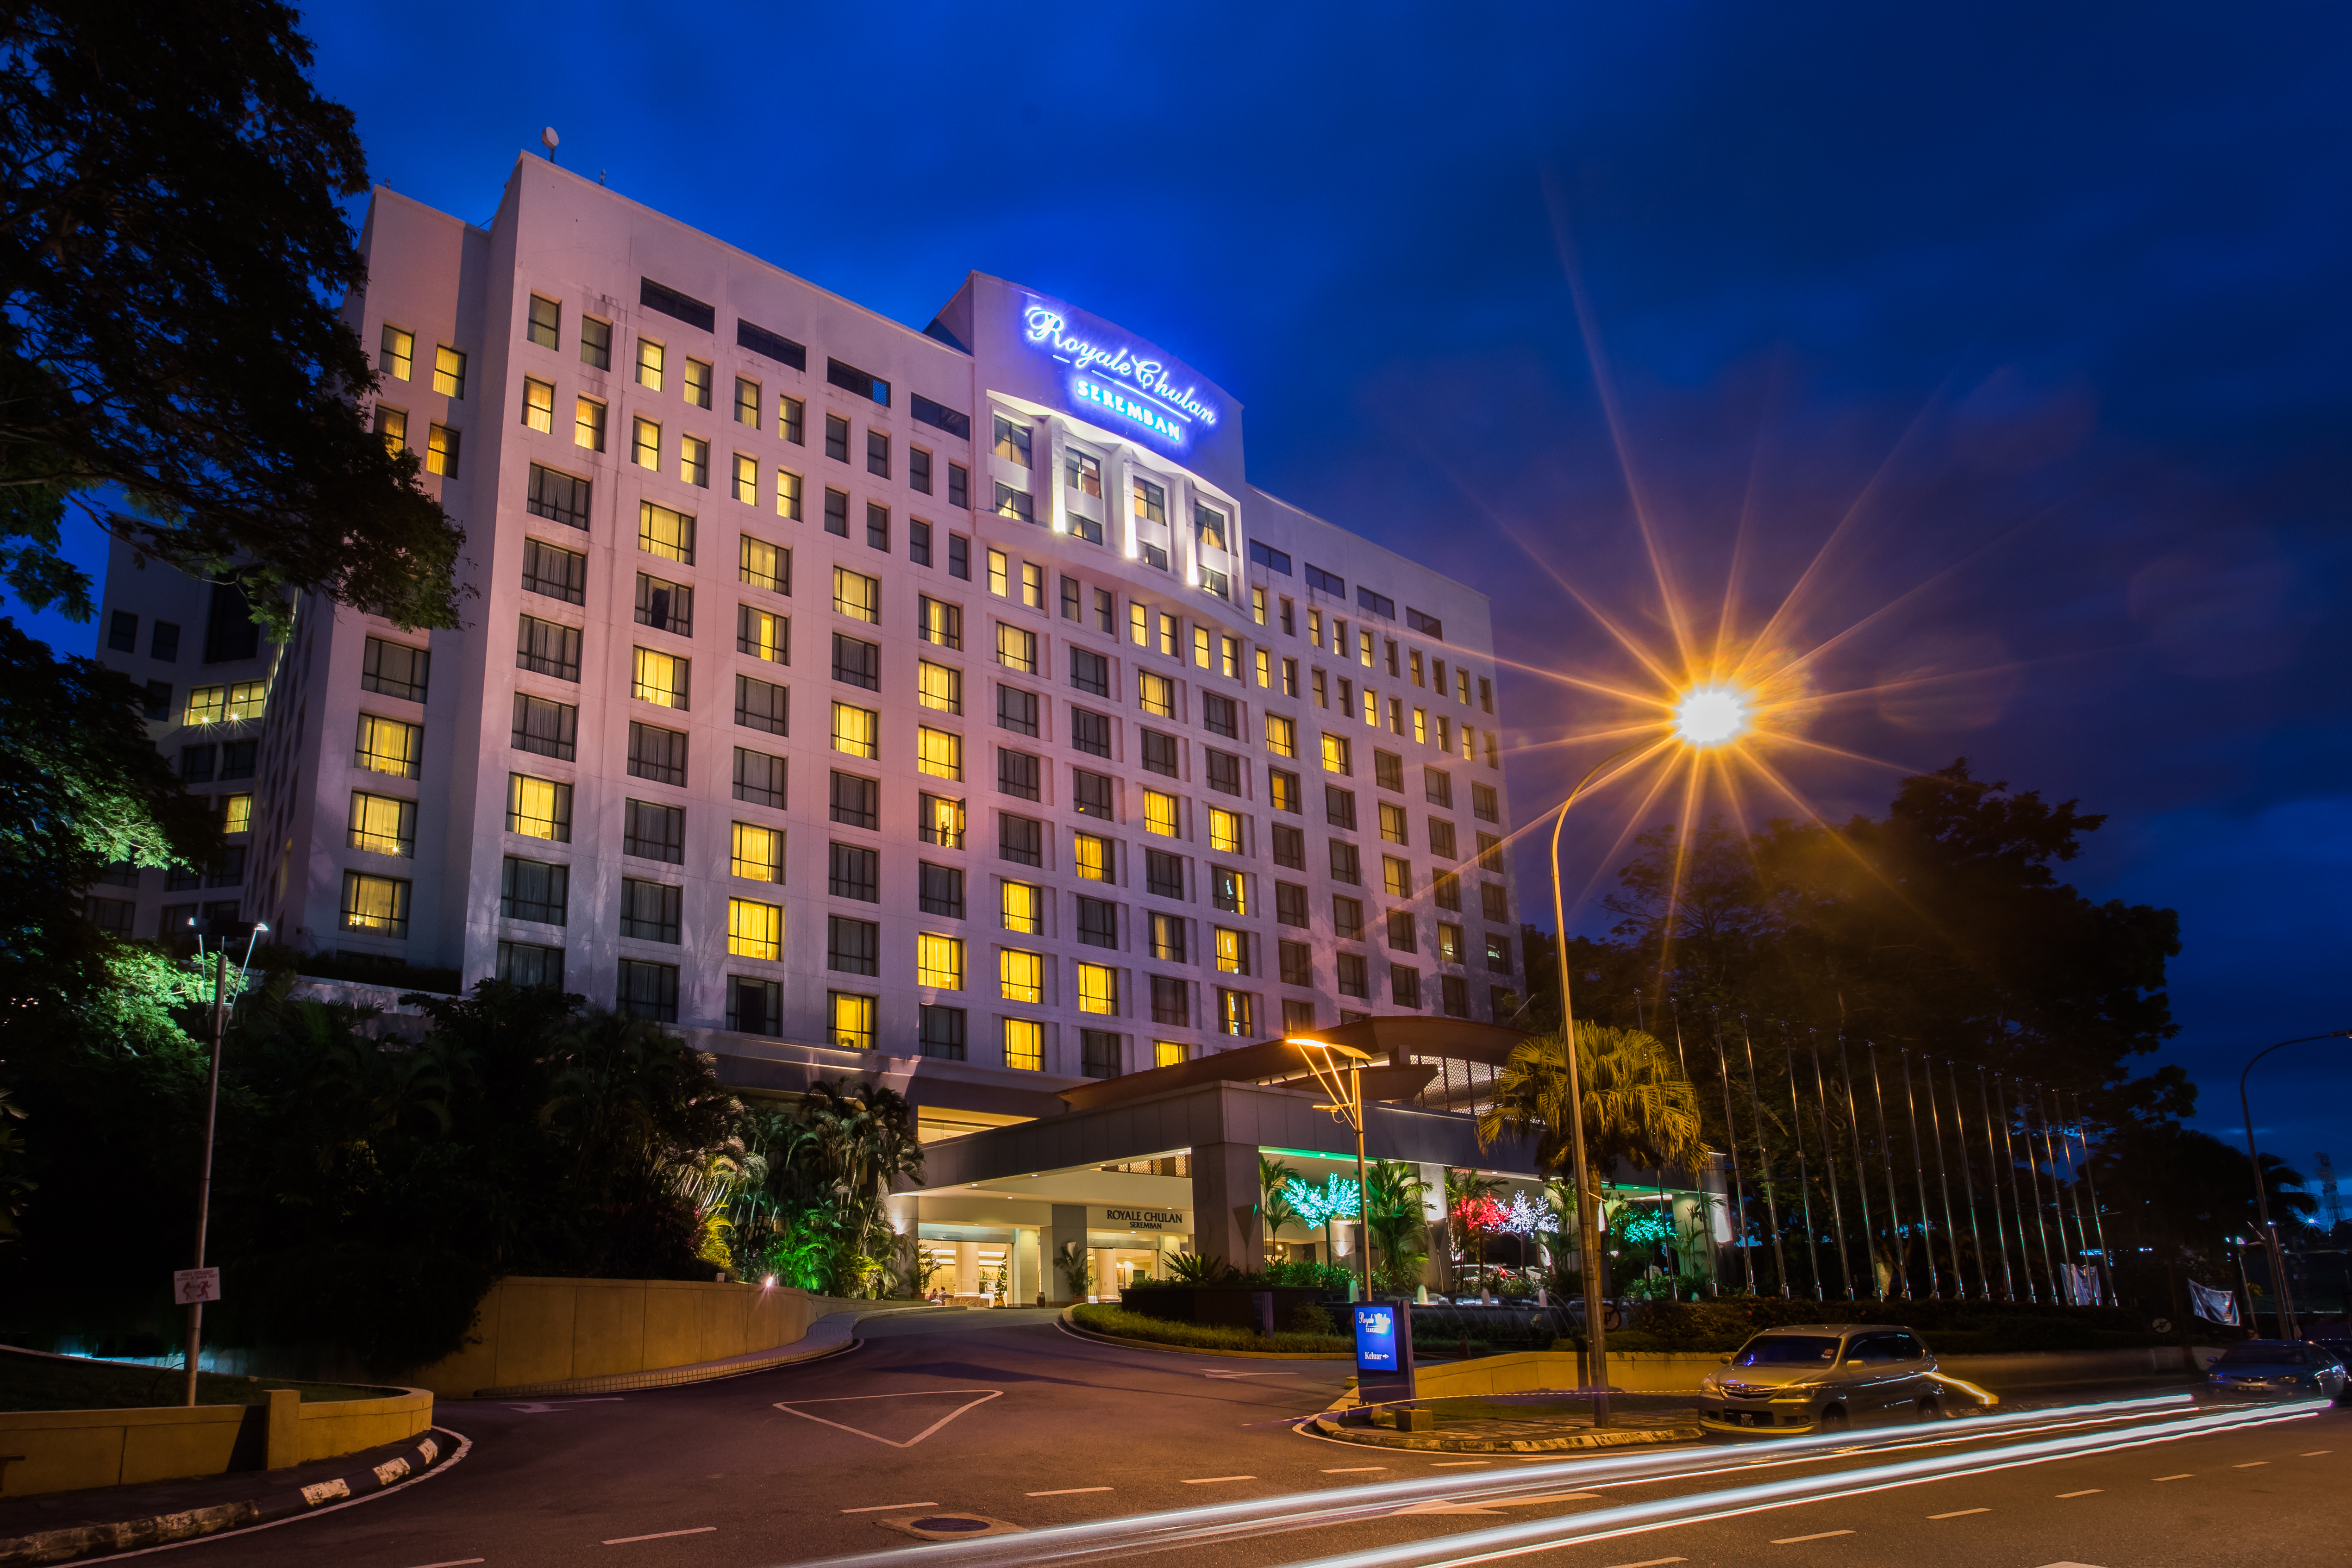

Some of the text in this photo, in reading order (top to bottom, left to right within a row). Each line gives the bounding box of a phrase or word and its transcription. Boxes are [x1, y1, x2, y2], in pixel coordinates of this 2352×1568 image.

[1025, 306, 1215, 425] Royale Chulan
[1077, 380, 1182, 441] SEREMBAN
[1107, 1209, 1182, 1224] ROYALE CHULAN
[1129, 1221, 1162, 1230] SEREMBAN
[1364, 1351, 1382, 1360] Keluar
